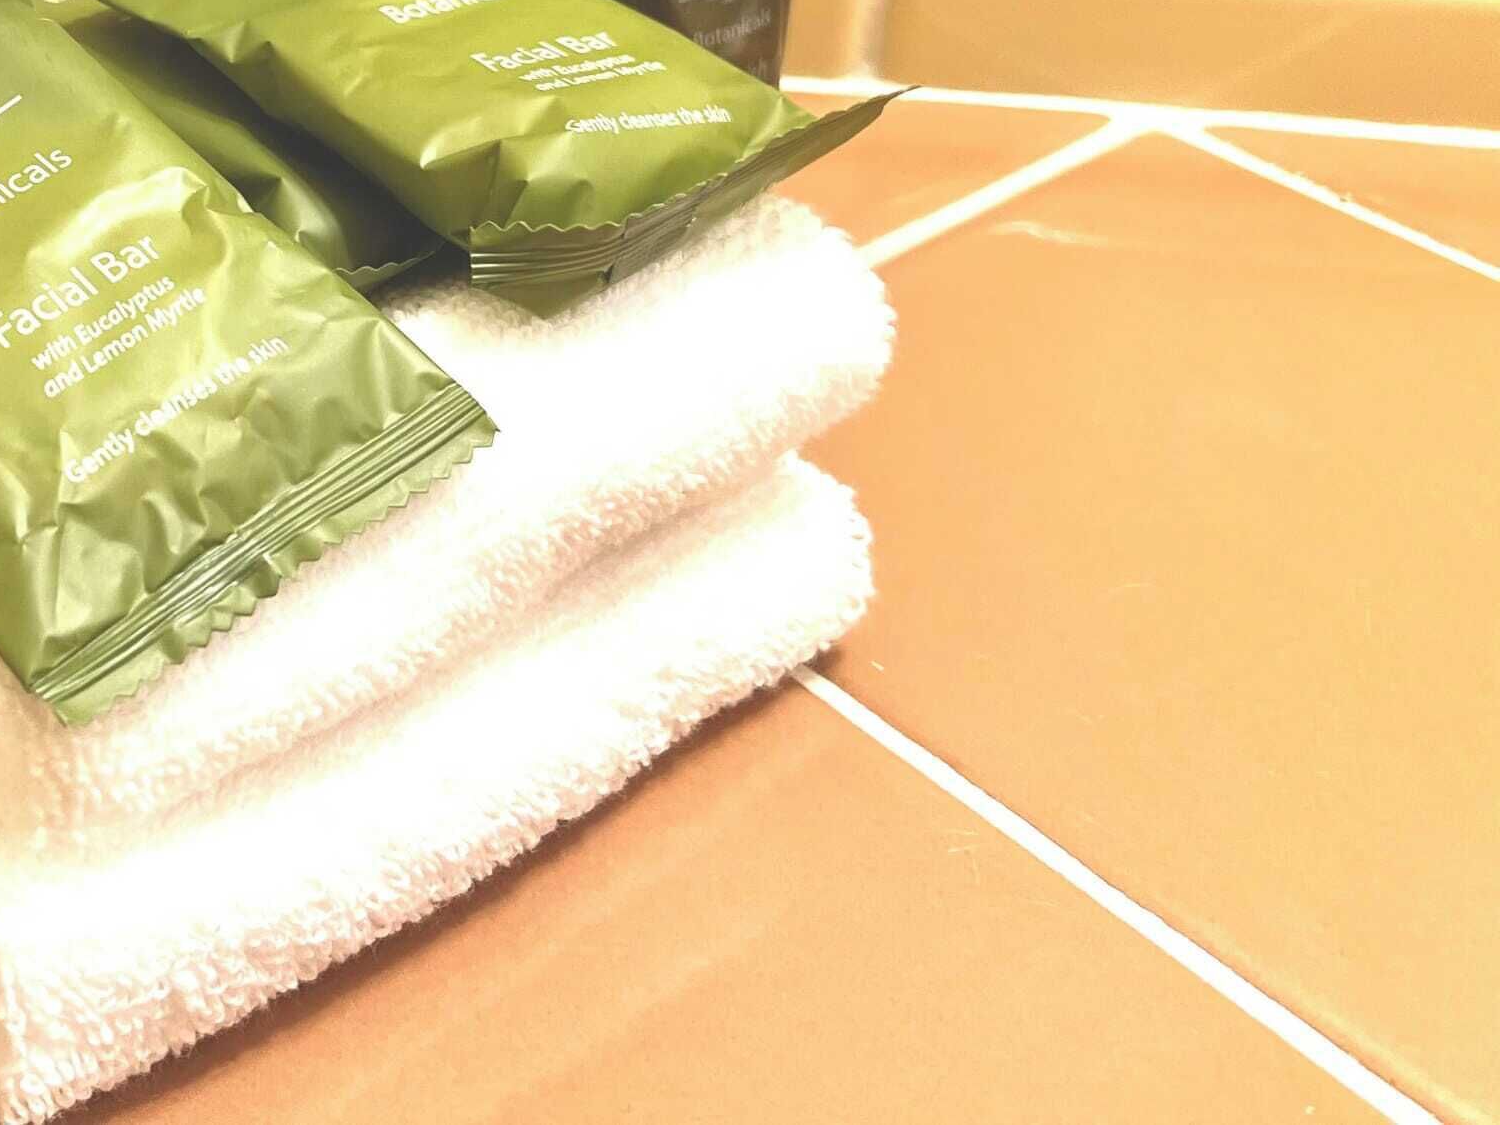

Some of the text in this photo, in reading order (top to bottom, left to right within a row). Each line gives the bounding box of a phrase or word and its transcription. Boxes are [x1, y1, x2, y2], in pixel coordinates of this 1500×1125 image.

[470, 31, 619, 73] Facial Bar
[551, 54, 636, 76] Eucalyptus
[535, 77, 571, 92] and
[561, 71, 620, 86] Lemon
[565, 104, 733, 135] Gently cleanses the skin
[89, 235, 160, 284] Bar
[31, 275, 176, 371] with Eucalyptus
[43, 286, 207, 399] and Lemon Myrtle
[65, 336, 290, 483] Gently cleanses the skin
